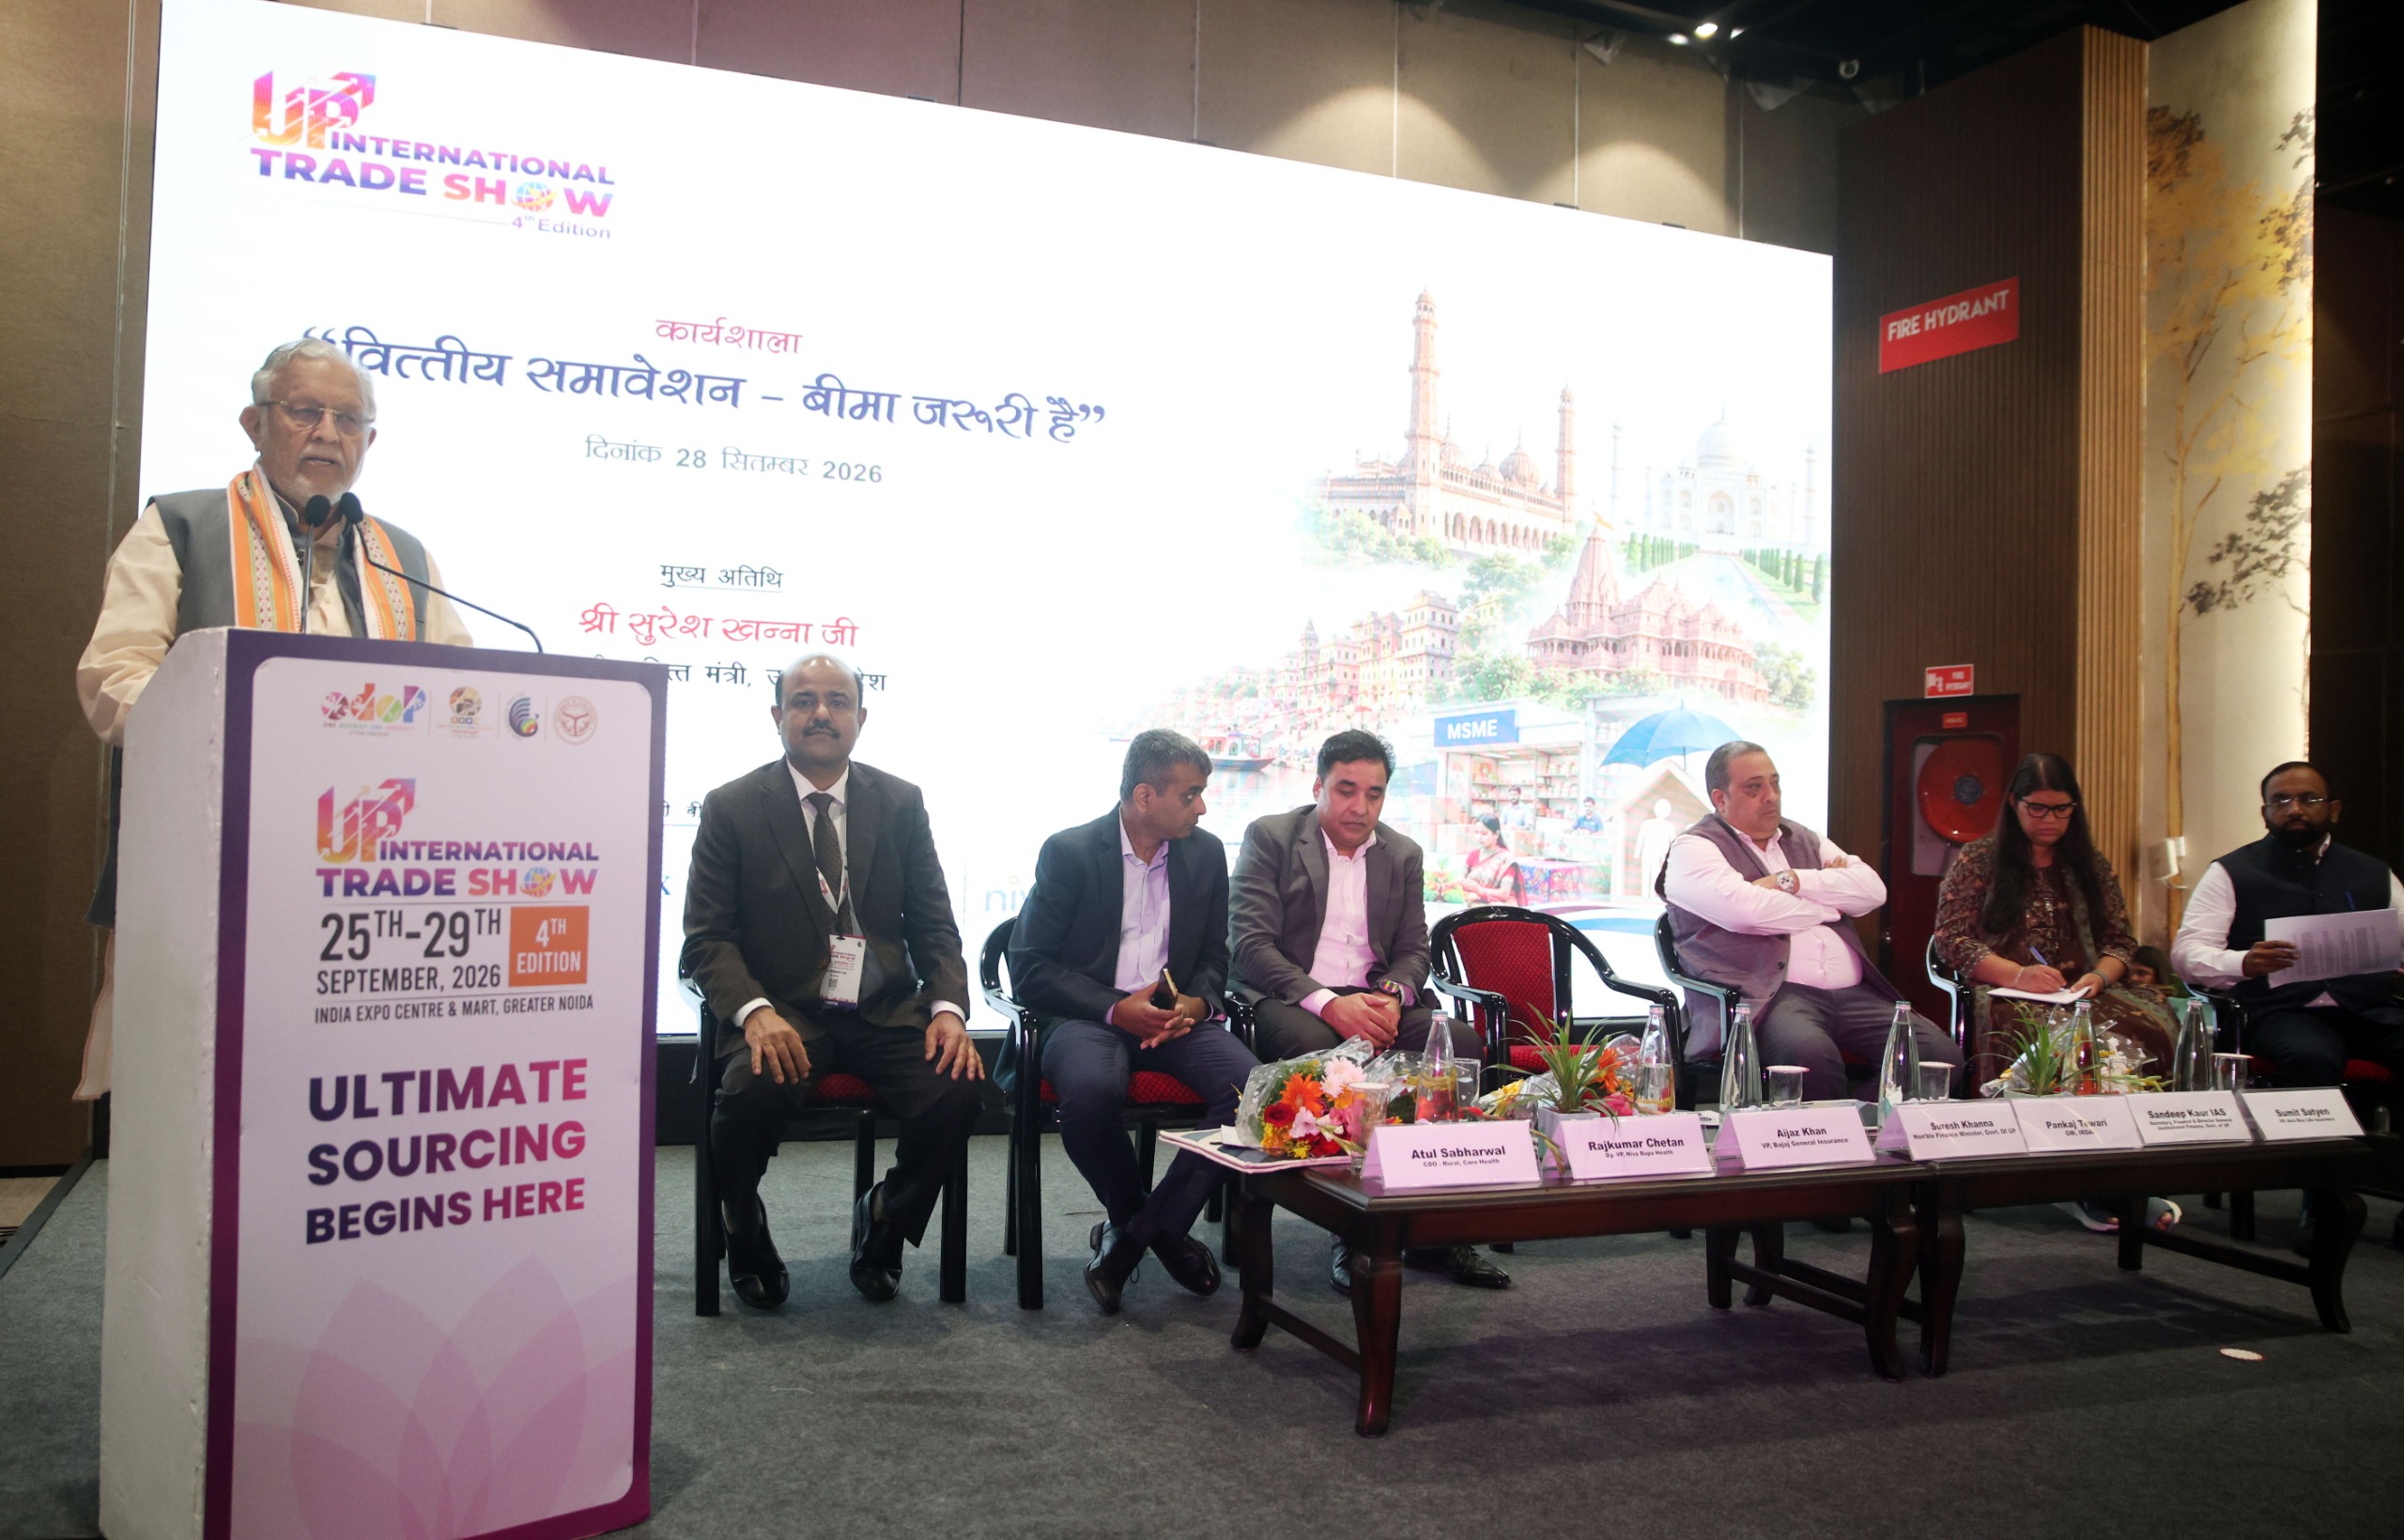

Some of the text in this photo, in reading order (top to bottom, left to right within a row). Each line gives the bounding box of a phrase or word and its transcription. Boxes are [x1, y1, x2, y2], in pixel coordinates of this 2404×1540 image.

[251, 147, 427, 195] TRADE
[331, 131, 614, 185] INTERNATIONAL
[512, 215, 610, 239] 4th Edition
[1888, 289, 2010, 342] FIRE HYDRANT
[656, 316, 802, 354] कार्यशाला
[527, 353, 747, 408] समावेशन
[803, 373, 901, 423] बीमा
[913, 393, 1038, 439] जरूरी
[585, 433, 883, 484] दिनांक 28 सितम्बर 2026
[660, 564, 783, 589] मुख्य अतिथि
[578, 602, 859, 647] श्री सुरेश खन्ना जी
[705, 661, 751, 687] मंत्री,
[1447, 718, 1498, 740] MSME
[380, 840, 599, 861] INTERNATIONAL
[316, 869, 456, 897] TRADE
[535, 918, 566, 947] 4TH
[516, 951, 581, 974] EDITION
[316, 964, 501, 994] SEPTEMBER, 2026
[315, 994, 593, 1024] INDIA EXPO CENTRE & MART, GREATER NOIDA
[309, 1058, 588, 1121] ULTIMATE
[1930, 1120, 1994, 1131] Suresh Khanna
[2045, 1120, 2077, 1129] Pankaj
[2148, 1110, 2186, 1119] Sandeep
[2210, 1108, 2227, 1116] IAS
[2275, 1108, 2330, 1117] Sumit Satyen
[1588, 1138, 1684, 1151] Rajkumar Chetan
[1777, 1127, 1826, 1138] Aijaz Khan
[308, 1120, 586, 1186] SOURCING
[1411, 1146, 1505, 1160] Atul Sabharwal
[306, 1178, 585, 1244] BEGINS HERE
